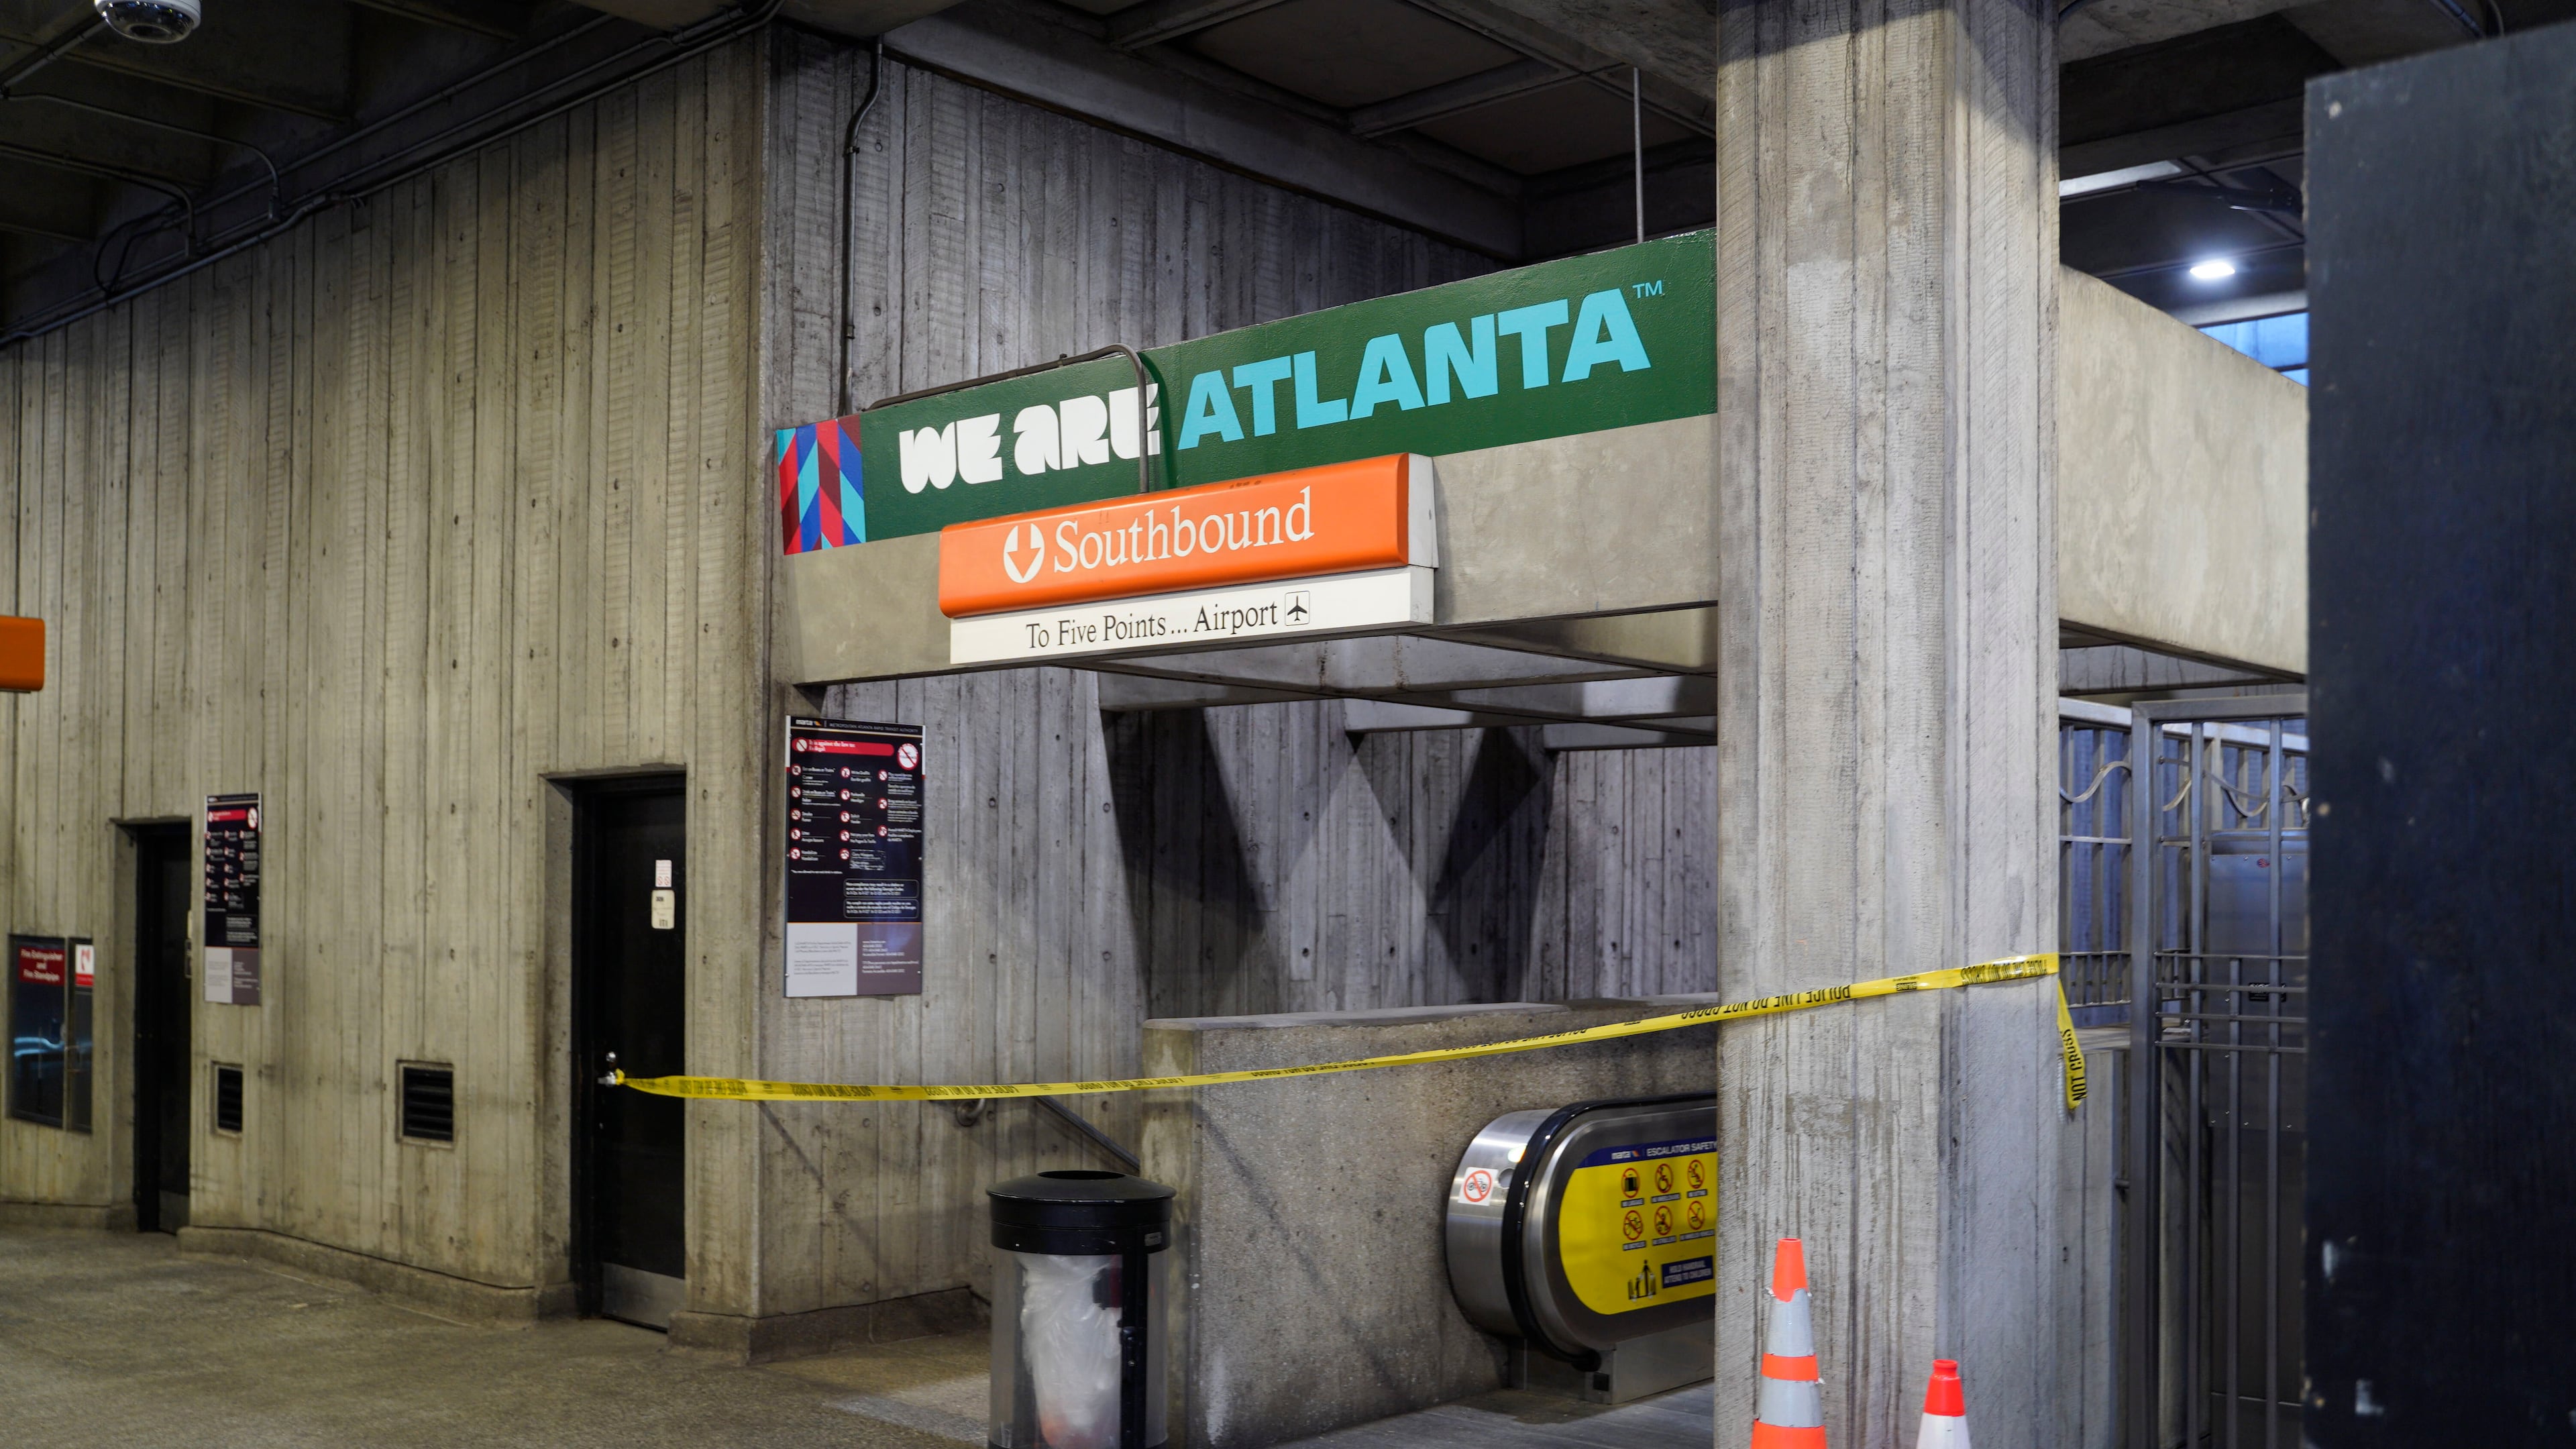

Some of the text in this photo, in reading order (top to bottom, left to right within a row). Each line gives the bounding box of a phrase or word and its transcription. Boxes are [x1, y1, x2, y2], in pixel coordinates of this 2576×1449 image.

[899, 413, 1002, 494] WE
[1177, 288, 1652, 450] ATLANTA
[1053, 485, 1315, 574] Southbound
[1026, 623, 1050, 649] To
[1058, 619, 1097, 645] Five
[1194, 601, 1278, 635] Airport
[21, 949, 63, 961] Fire Extinguisher
[36, 962, 47, 970] and
[23, 968, 60, 981] Fire Standpipe
[2071, 1075, 2087, 1101] NOT
[1646, 1144, 1690, 1157] ESCALATOR
[1668, 1264, 1682, 1273] HOLD
